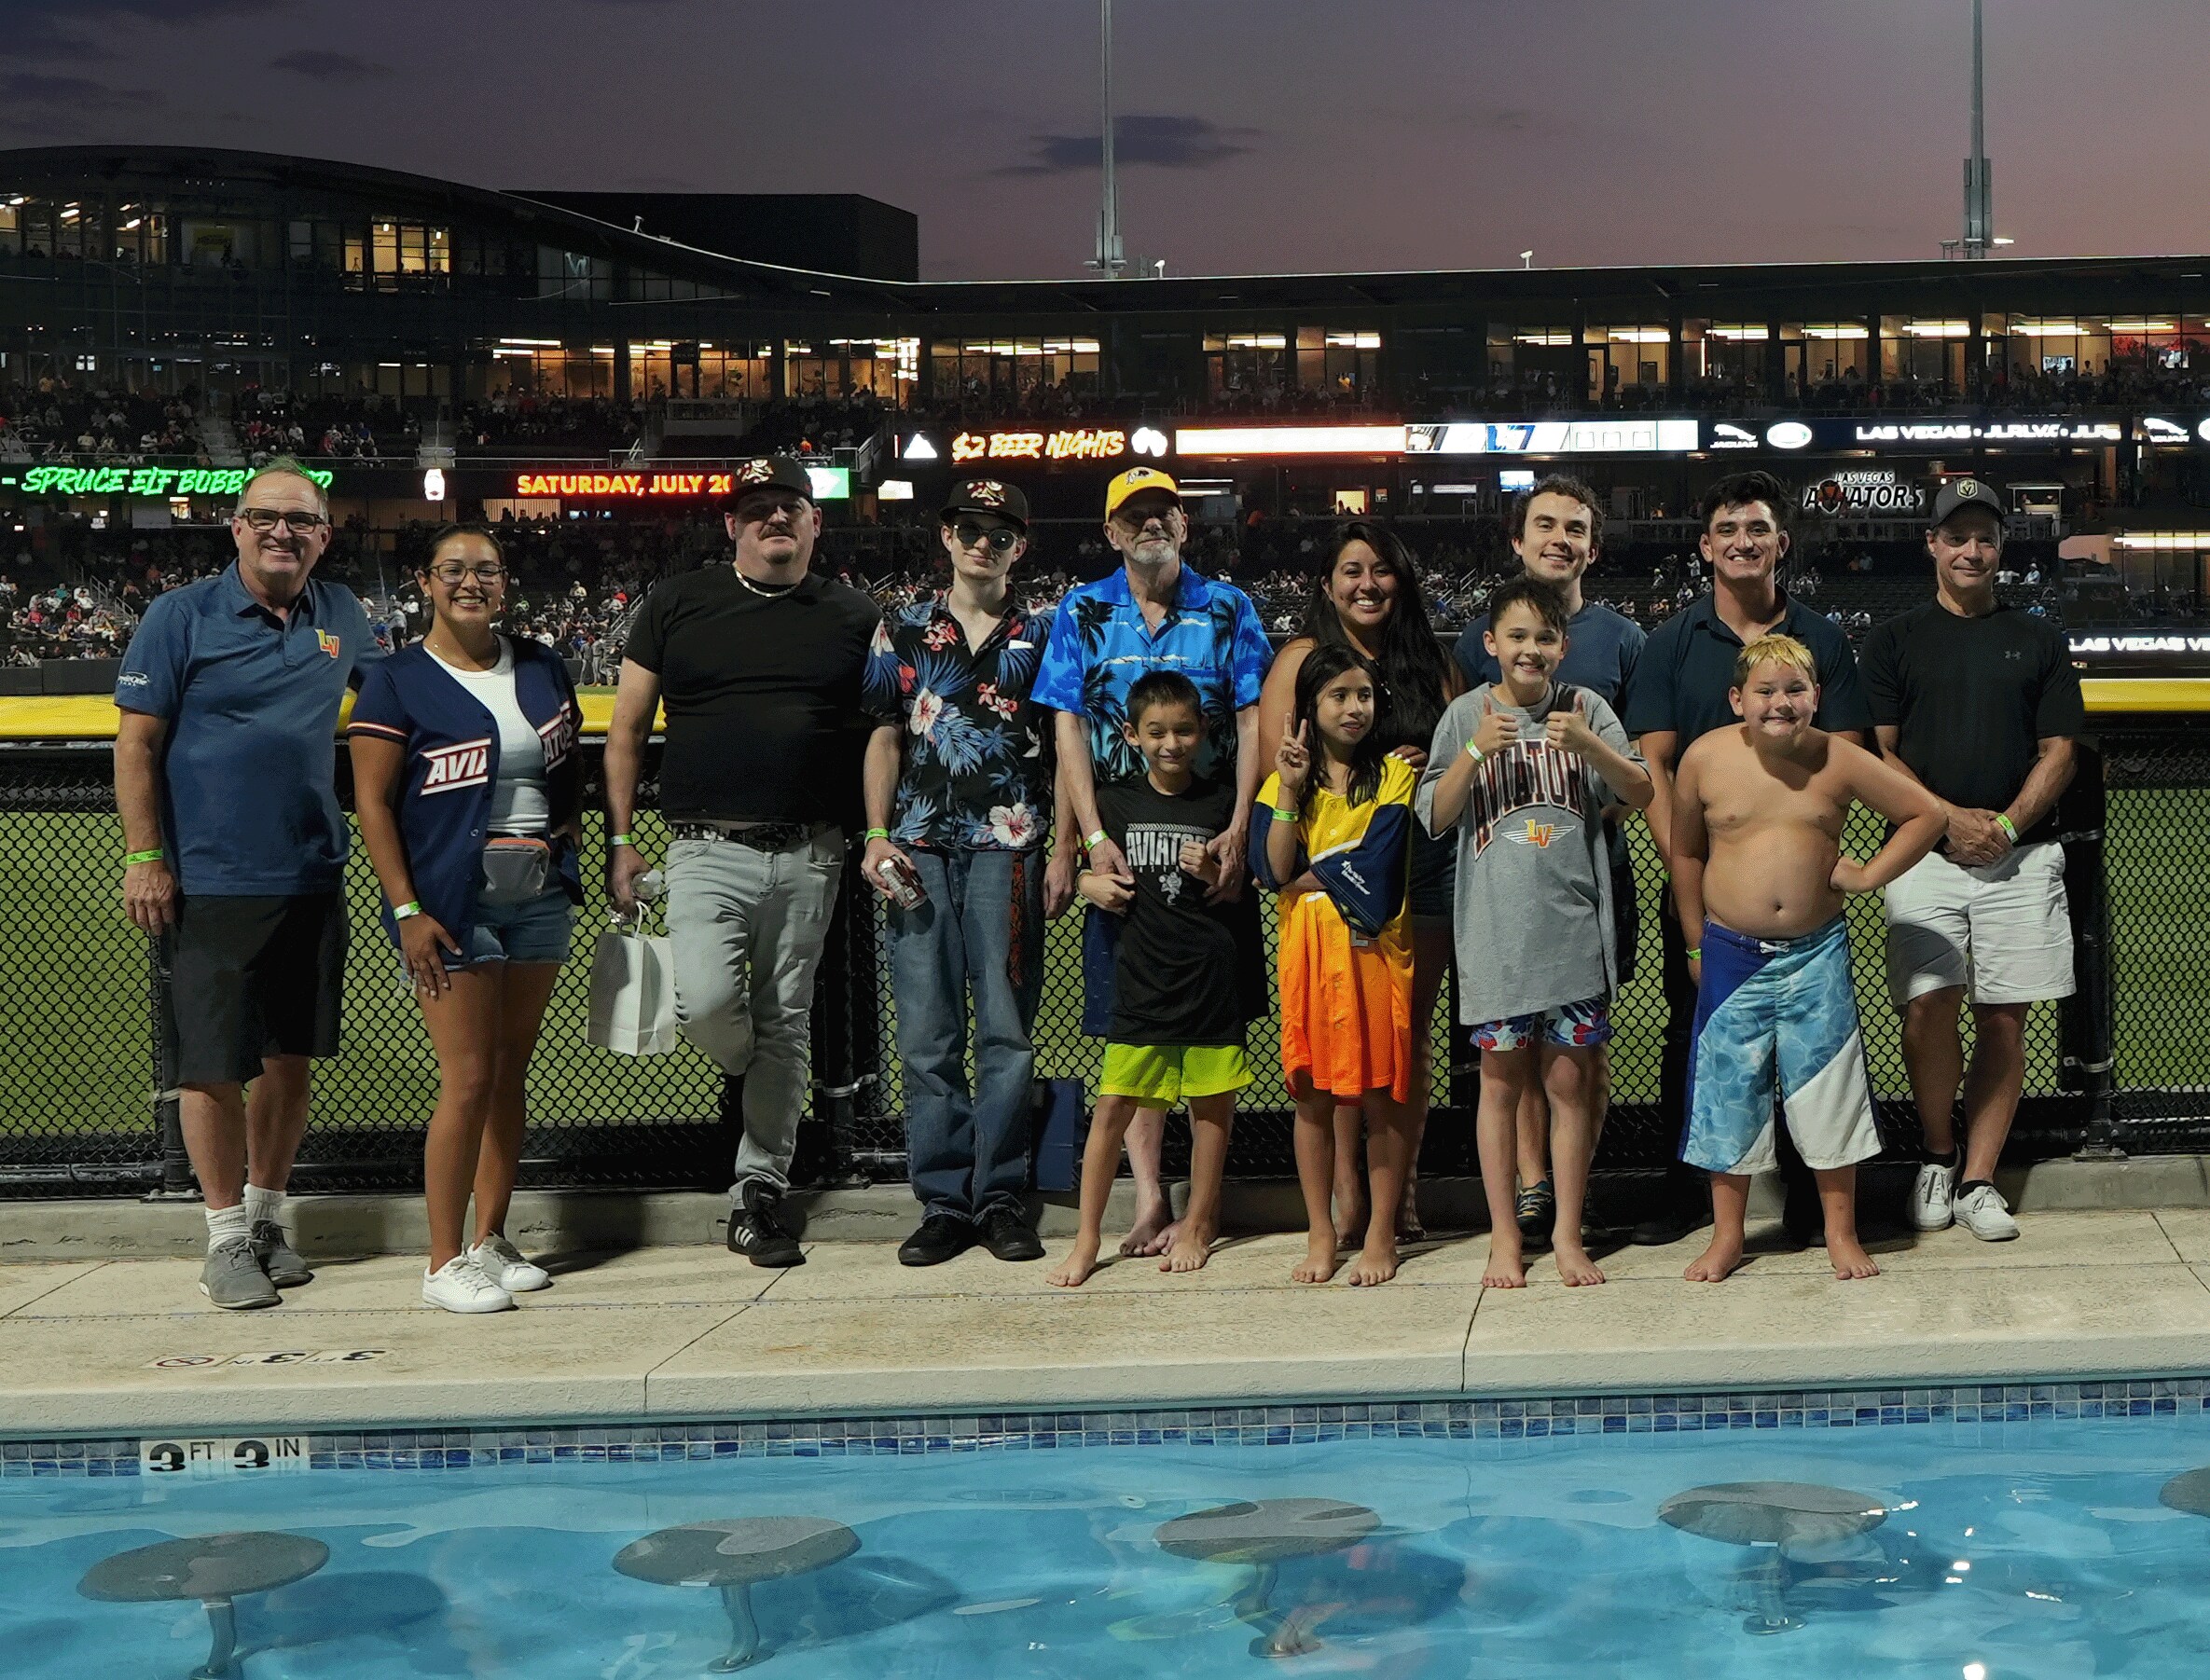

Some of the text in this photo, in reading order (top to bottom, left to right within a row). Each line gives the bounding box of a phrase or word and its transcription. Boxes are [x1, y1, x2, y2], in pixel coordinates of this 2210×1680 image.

[952, 430, 1126, 461] $2 BEER NIGHTS
[1856, 425, 1899, 440] LAS
[1899, 424, 1972, 439] VEGAS
[21, 466, 131, 495] SPRUCE
[128, 466, 179, 496] ELF
[517, 474, 645, 497] SATURDAY,
[648, 474, 705, 494] JULY
[1834, 471, 1896, 484] LAS VEGAS
[2069, 637, 2110, 652] LAS
[2111, 637, 2187, 652] VEGAS
[1524, 819, 1554, 848] LV
[1126, 831, 1208, 867] AVIAT
[149, 1438, 301, 1472] 3 FT 3 IN
